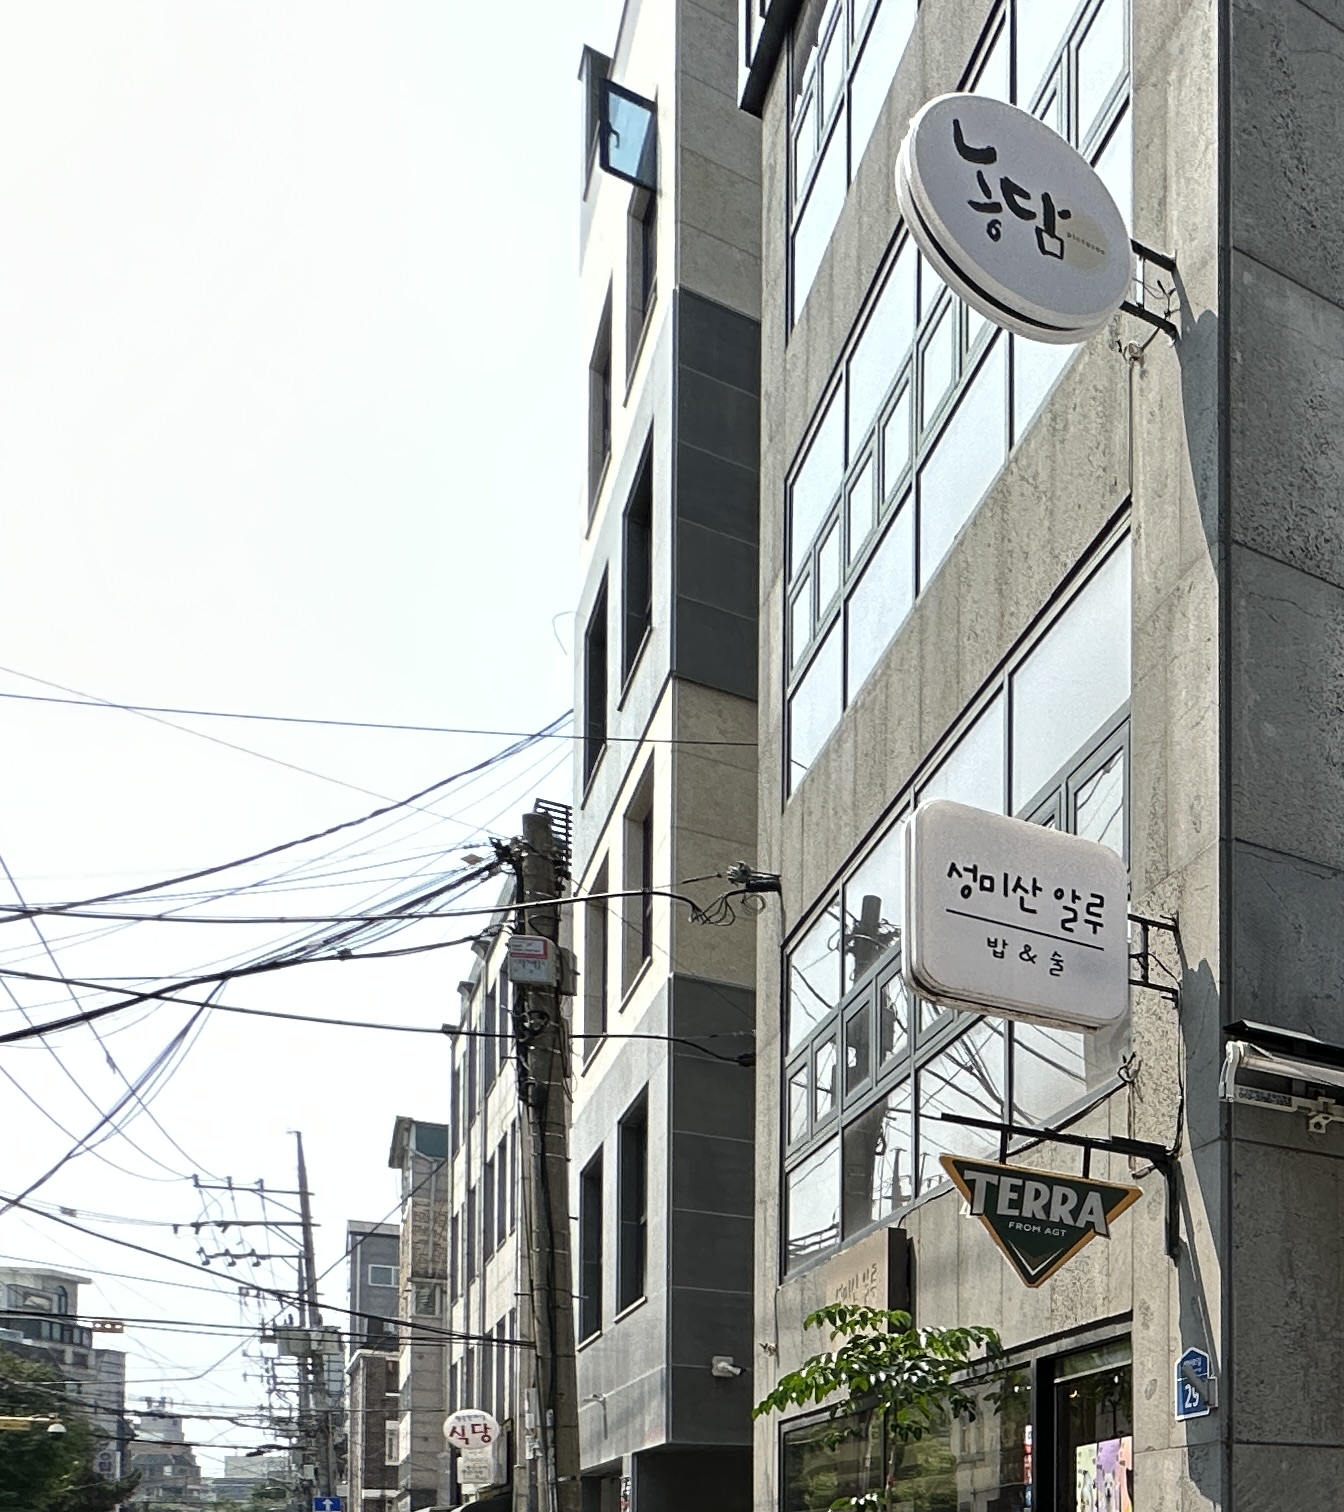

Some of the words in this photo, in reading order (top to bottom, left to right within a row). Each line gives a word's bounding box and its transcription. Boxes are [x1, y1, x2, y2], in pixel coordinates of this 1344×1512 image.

[953, 118, 1071, 260] 농담
[947, 862, 1043, 914] 성미산
[1053, 888, 1105, 934] 알루
[987, 937, 1009, 959] 밥
[1018, 944, 1038, 964] &
[1049, 951, 1064, 977] 술
[963, 1169, 1111, 1239] TERRA
[1008, 1221, 1041, 1235] FROM
[1044, 1226, 1067, 1238] AGT
[1184, 1384, 1200, 1409] 25
[449, 1423, 492, 1445] 식당
